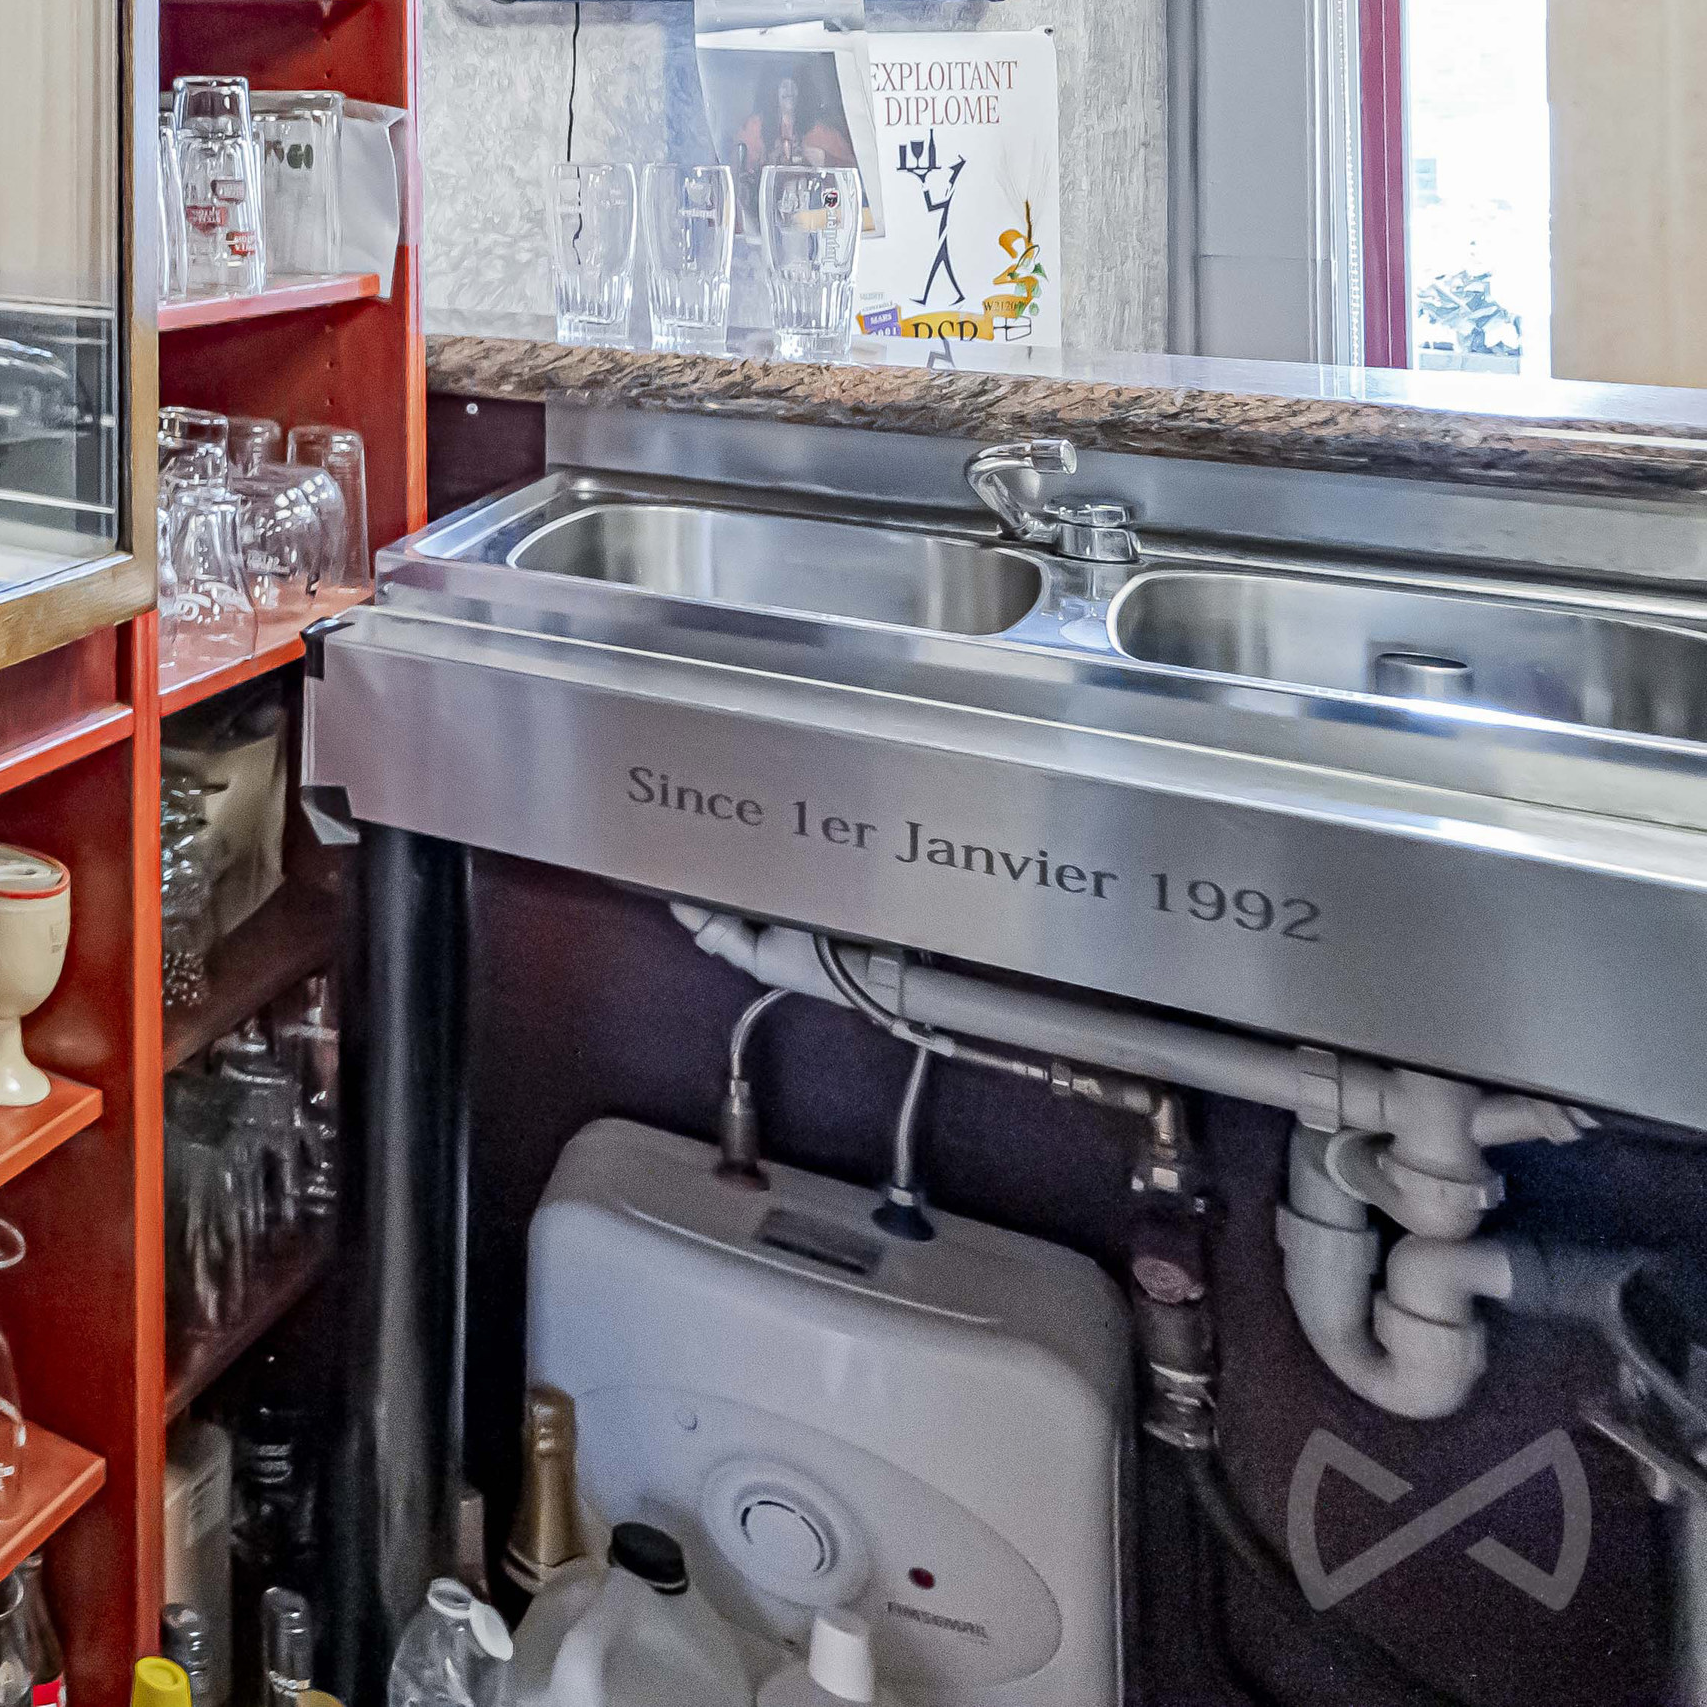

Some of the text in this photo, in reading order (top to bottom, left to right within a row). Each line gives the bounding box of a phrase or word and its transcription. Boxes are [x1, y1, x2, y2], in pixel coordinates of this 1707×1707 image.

[870, 60, 1018, 92] EXPLOITANT
[884, 95, 1000, 127] DIPLOME
[626, 765, 1325, 944] Since 1er Janvier 1992
